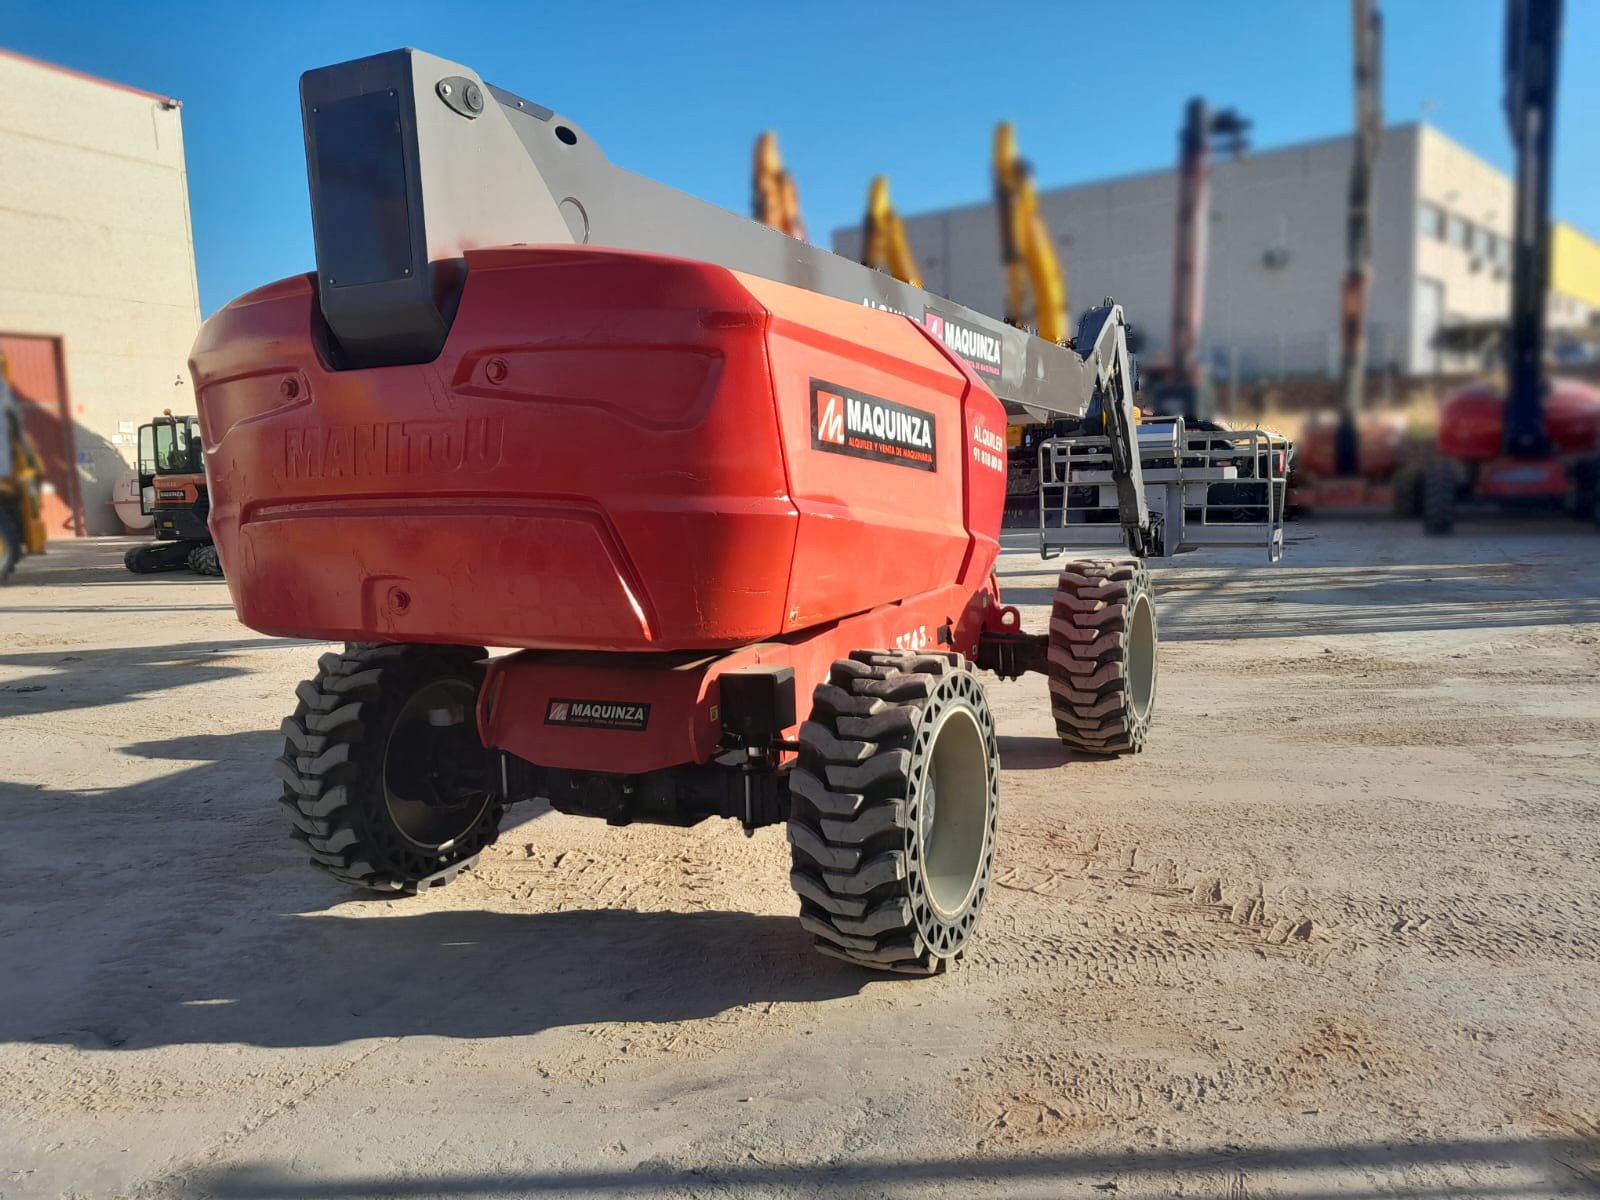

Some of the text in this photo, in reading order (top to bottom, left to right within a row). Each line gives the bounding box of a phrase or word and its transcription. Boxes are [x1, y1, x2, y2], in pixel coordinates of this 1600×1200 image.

[945, 322, 1000, 364] MAQUINZA
[847, 398, 932, 448] MAQUINZA
[973, 425, 1003, 454] ALQUILER
[285, 416, 504, 478] MANITOU
[848, 437, 873, 450] ALQUILER
[879, 443, 895, 456] VENTA
[571, 703, 643, 721] MAQUINZA
